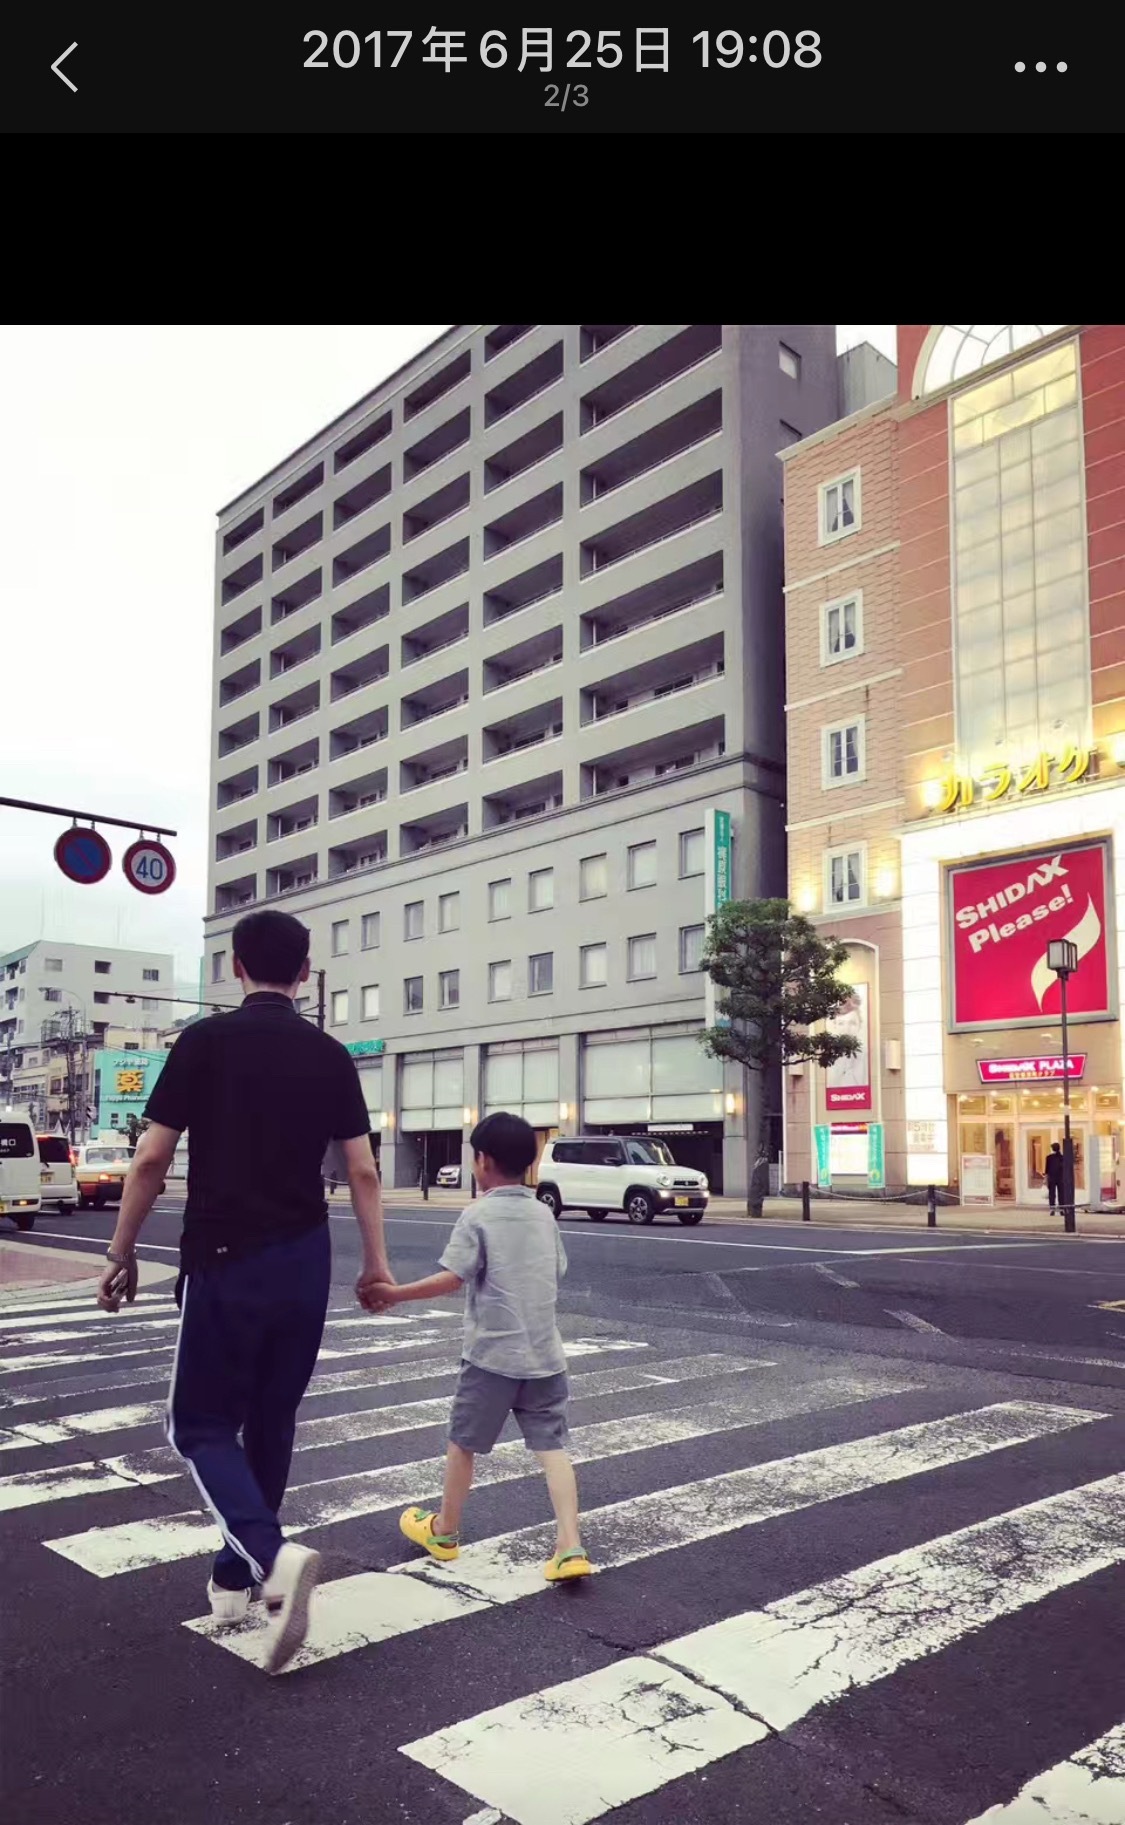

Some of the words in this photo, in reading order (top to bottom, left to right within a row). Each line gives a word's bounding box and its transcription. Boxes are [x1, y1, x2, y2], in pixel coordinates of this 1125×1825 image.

[938, 744, 1095, 812] カラオケ
[135, 855, 163, 880] 40
[955, 854, 1070, 930] SHIDAX
[967, 883, 1074, 954] Please!
[830, 1091, 867, 1103] SHIDAX
